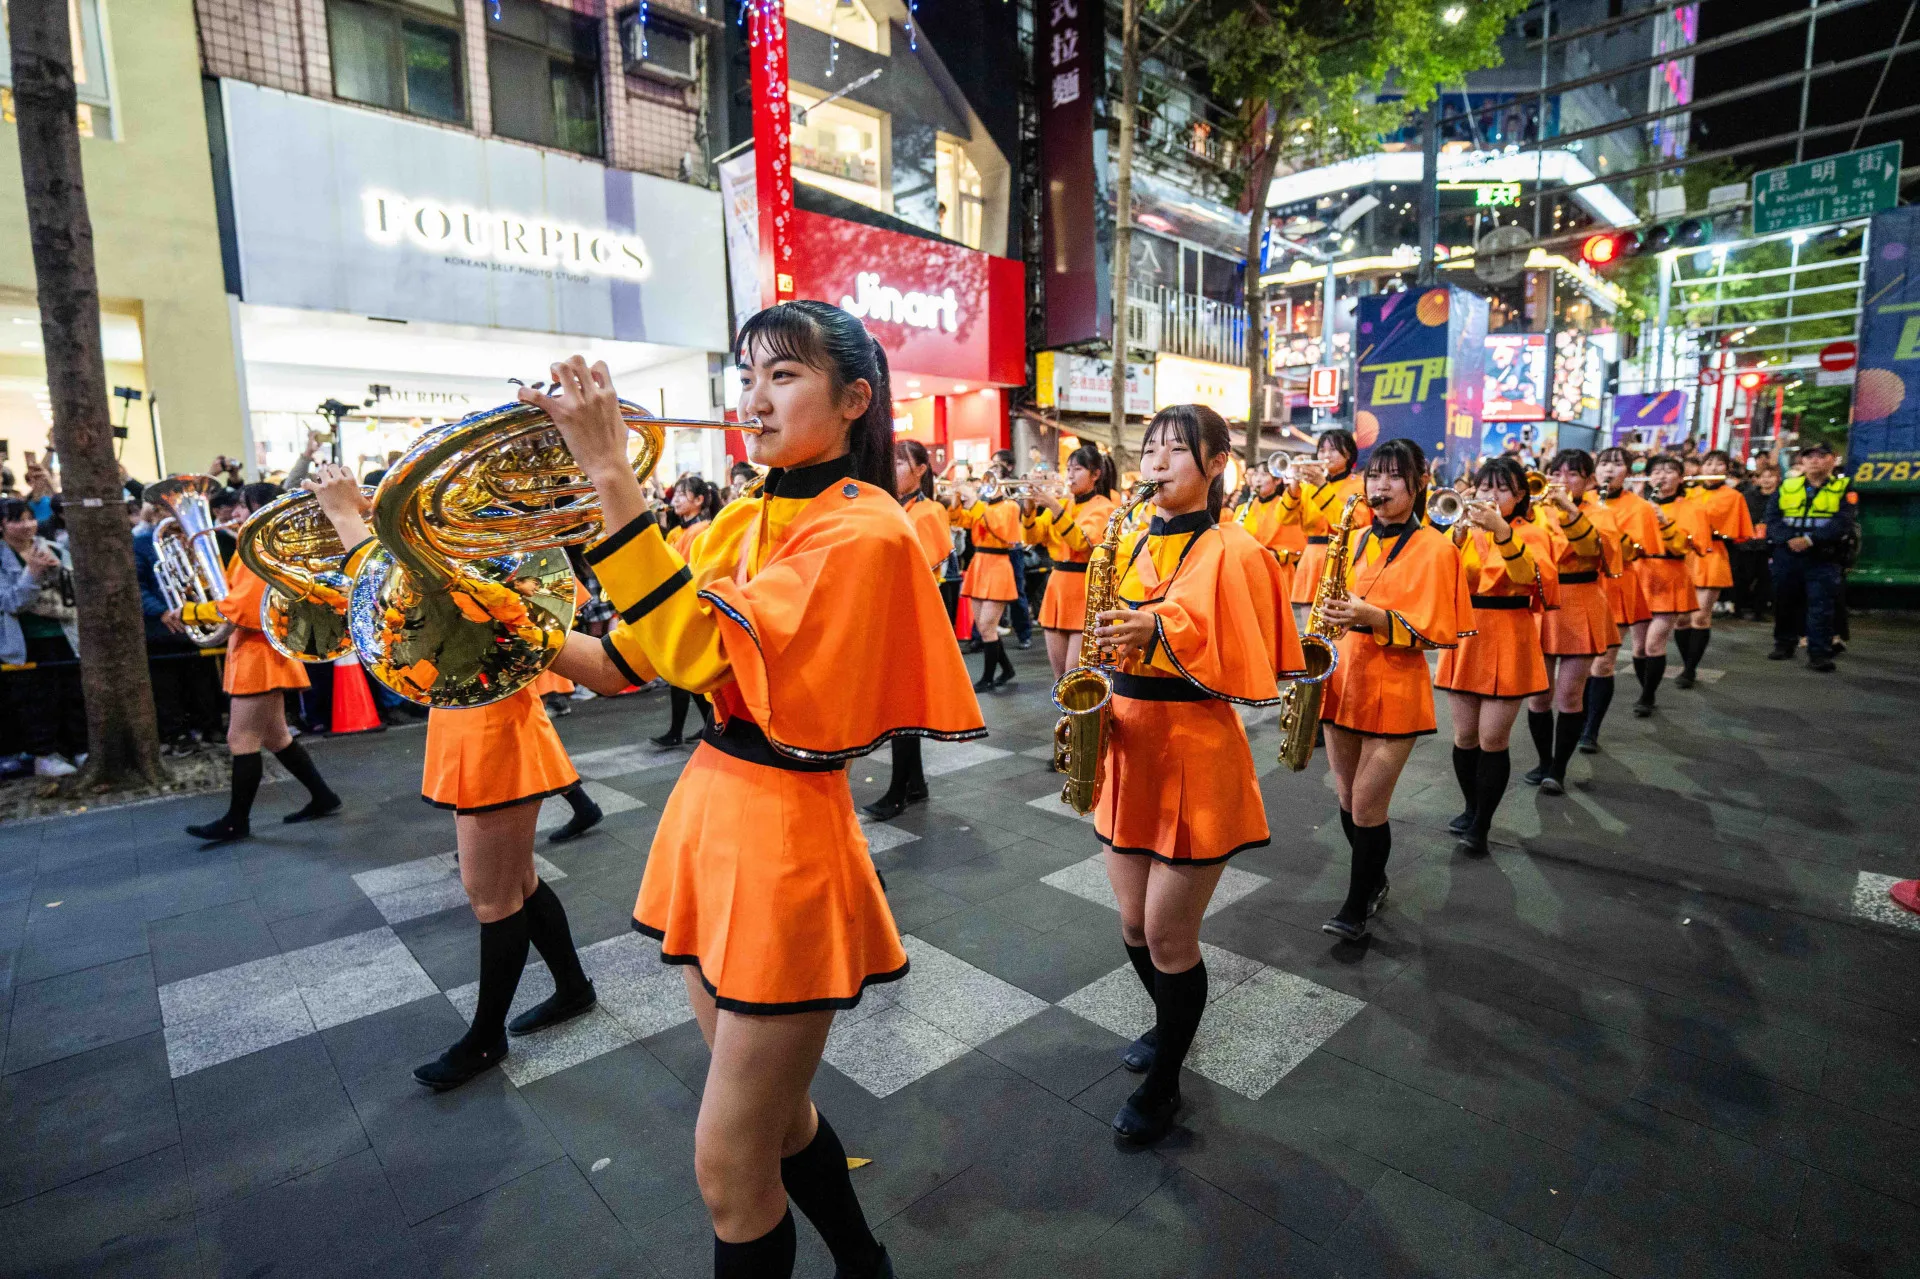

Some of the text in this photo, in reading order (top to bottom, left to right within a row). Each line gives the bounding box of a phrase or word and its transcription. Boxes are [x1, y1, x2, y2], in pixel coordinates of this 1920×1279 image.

[1769, 150, 1884, 193] 昆明街
[369, 192, 649, 275] FOURPICS
[444, 256, 590, 284] KOREAN SELF PHOTO STUDIO
[841, 271, 958, 332] Jinart
[388, 390, 470, 404] OURPICS
[1360, 356, 1455, 406] 西門
